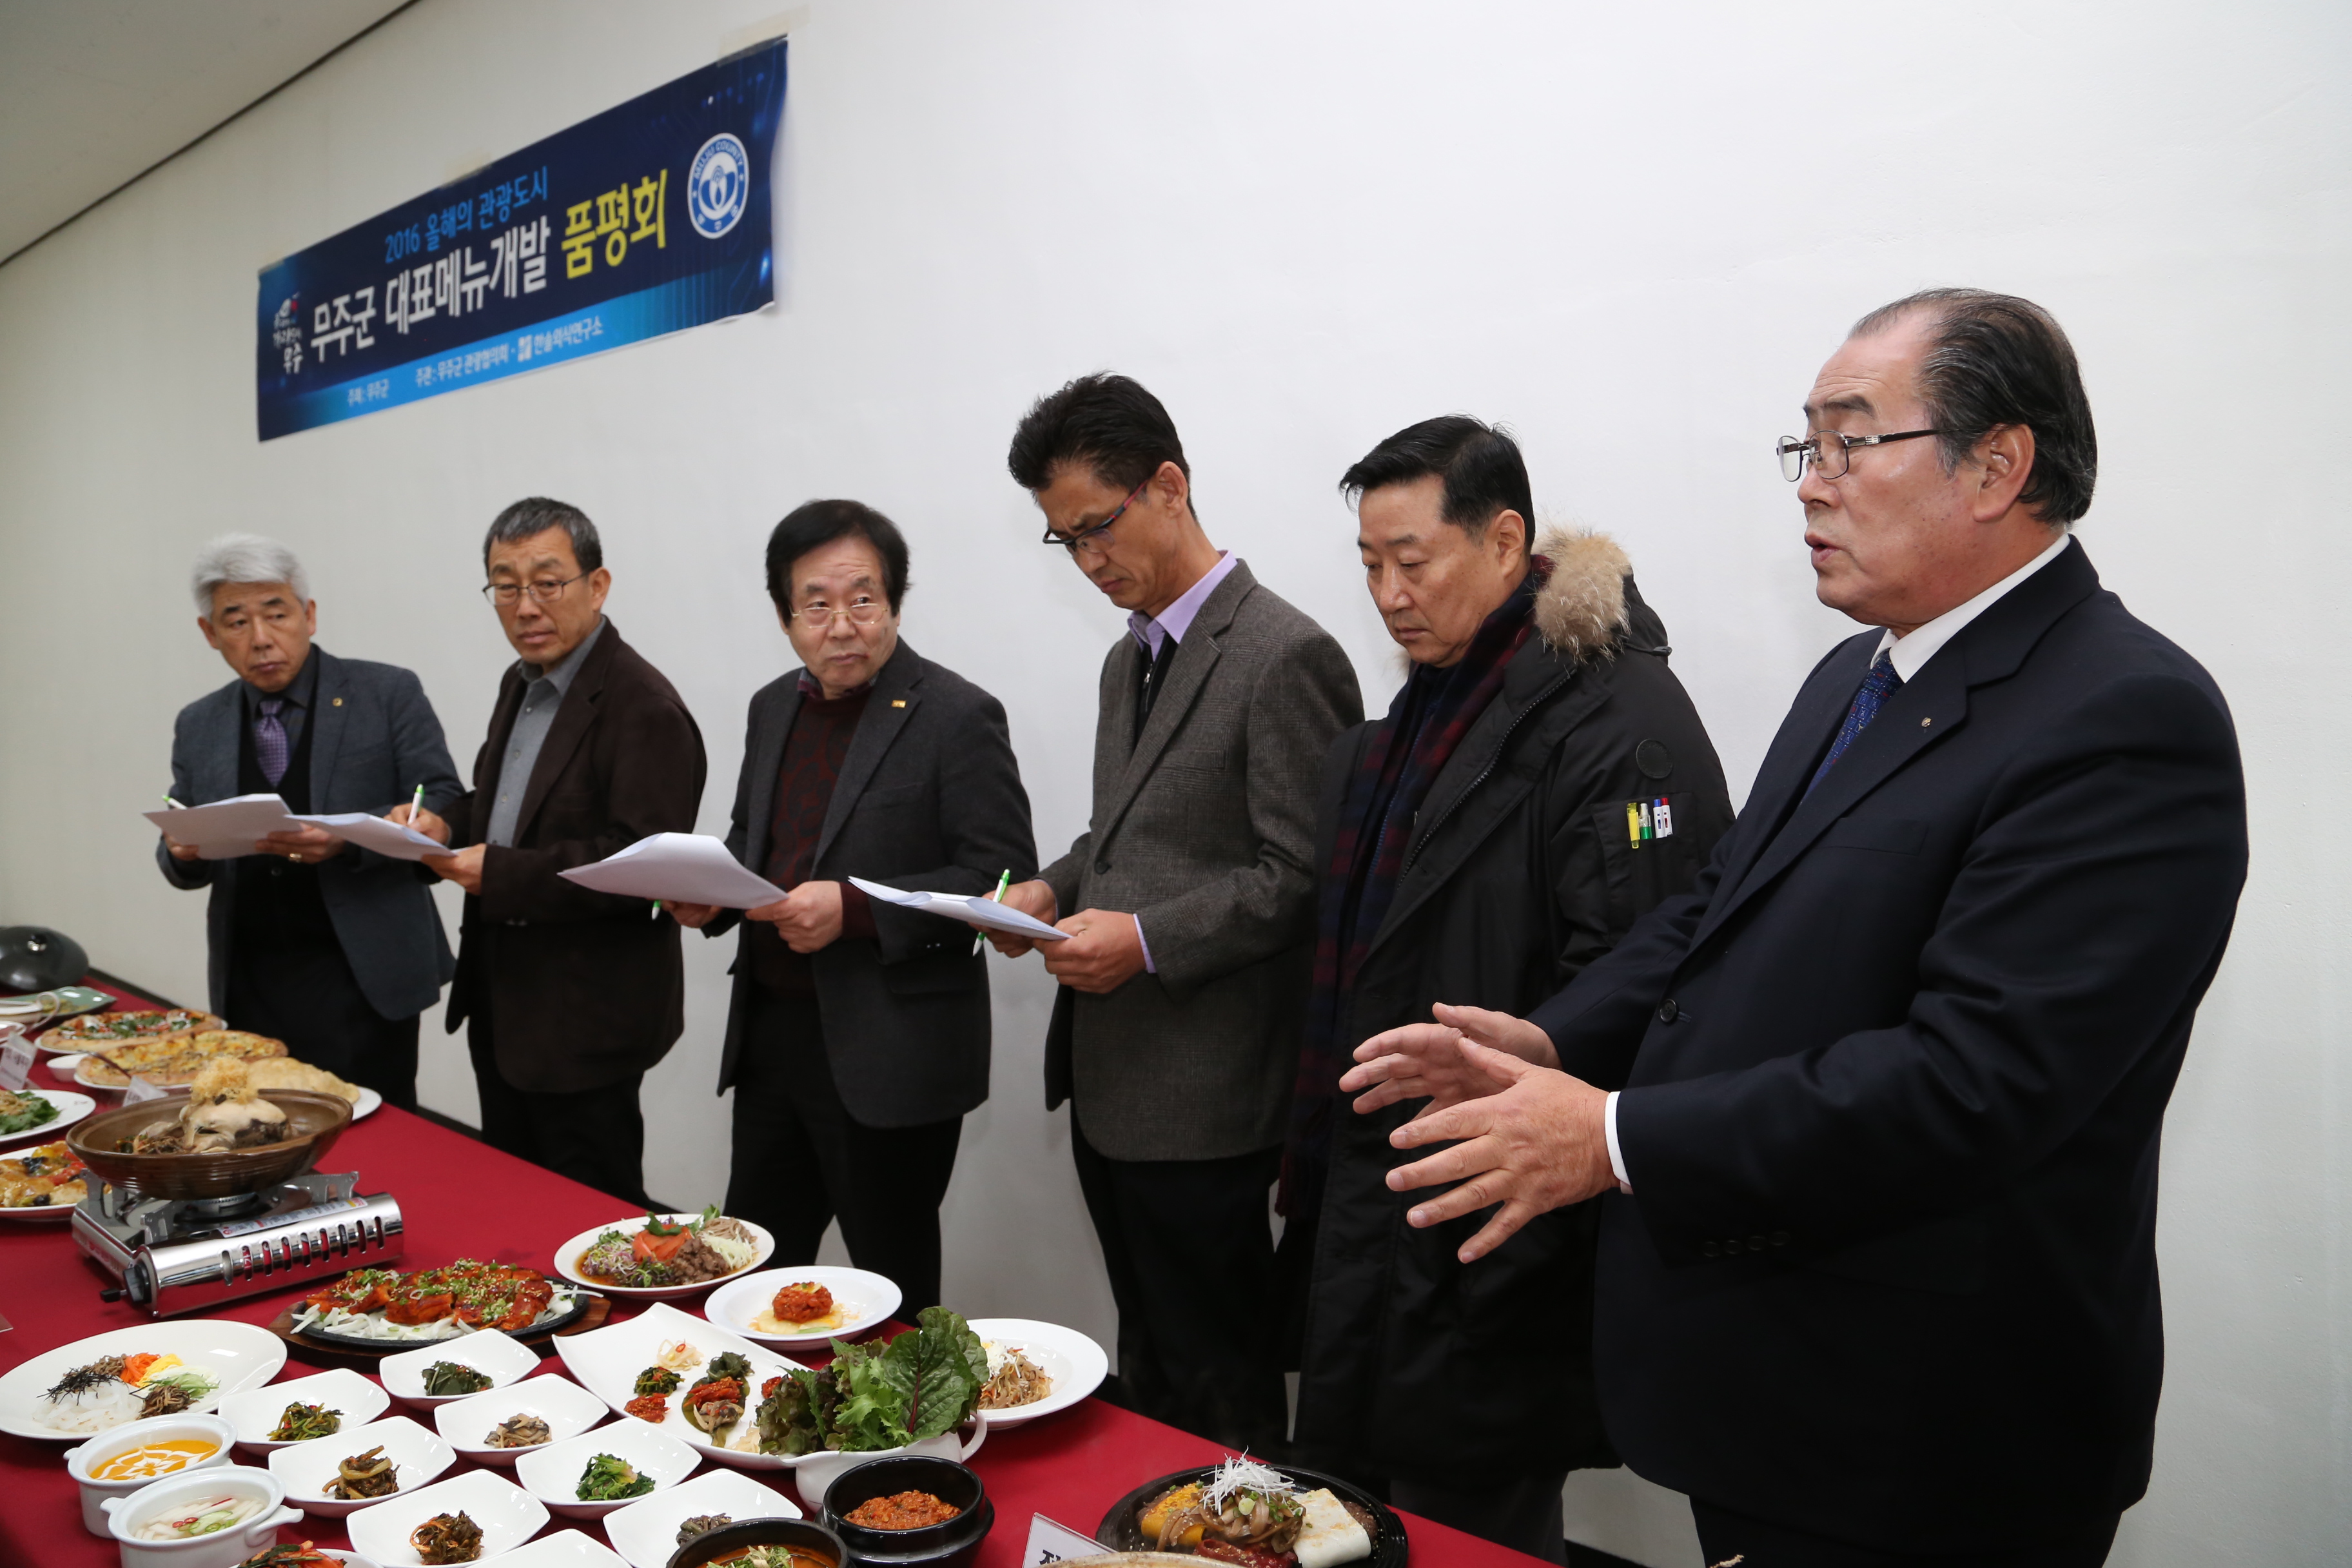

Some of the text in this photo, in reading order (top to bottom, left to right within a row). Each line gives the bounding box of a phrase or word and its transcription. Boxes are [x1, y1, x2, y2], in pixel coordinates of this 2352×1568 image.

[715, 140, 743, 166] COUNTY
[385, 165, 547, 264] 2016 올해의 관광도시
[311, 168, 668, 363] 무주군 대표메뉴개발 품평회
[438, 356, 462, 381] 무주군
